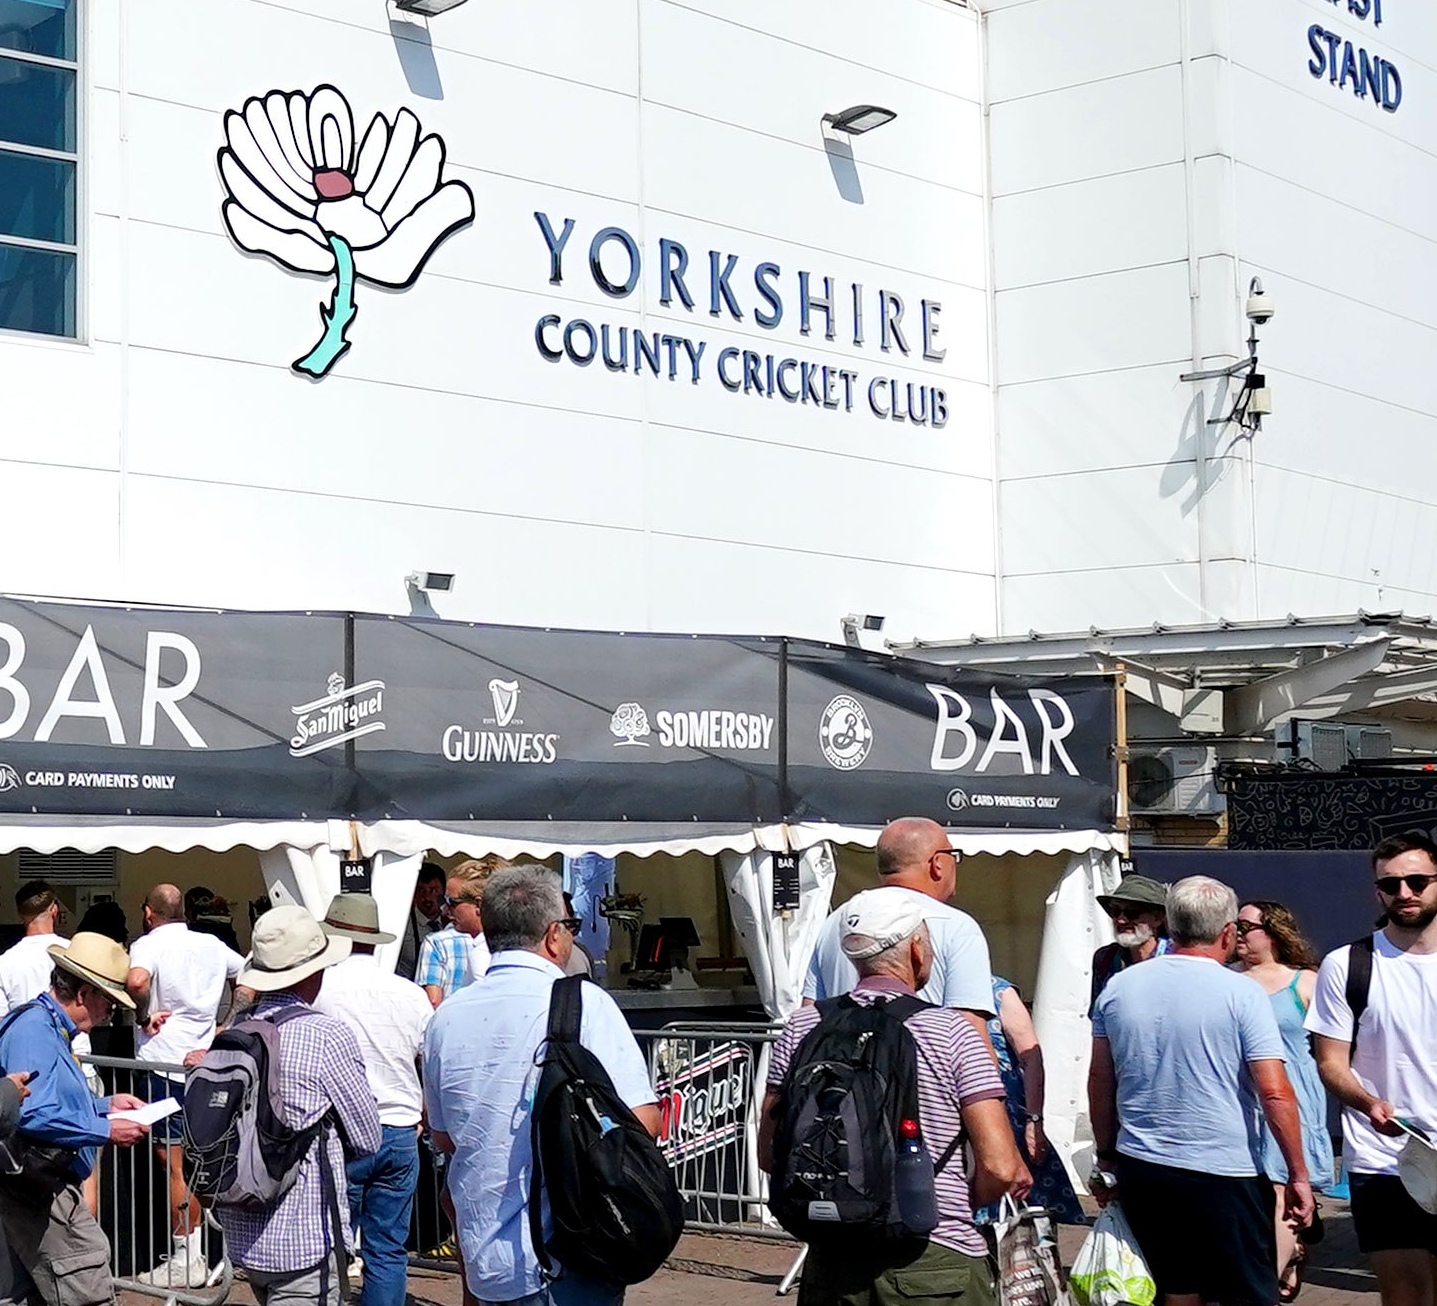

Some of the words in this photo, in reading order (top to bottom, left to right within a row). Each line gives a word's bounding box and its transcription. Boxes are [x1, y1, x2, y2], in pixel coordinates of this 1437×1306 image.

[1307, 24, 1403, 113] STAND
[533, 211, 948, 363] YORKSHIRE
[534, 314, 707, 384] COUNTY
[717, 346, 859, 412] CRICKET
[867, 375, 951, 429] CLUB
[442, 725, 557, 764] GUINNESS
[656, 709, 774, 750] SOMERSBY
[925, 682, 1080, 777] BAR
[25, 771, 64, 786] CARD
[67, 772, 139, 789] PAYMENTS
[142, 774, 176, 790] ONLY
[971, 795, 994, 807] CARD
[1037, 796, 1061, 808] ONLY
[345, 865, 365, 877] BAR
[777, 858, 795, 869] BAR
